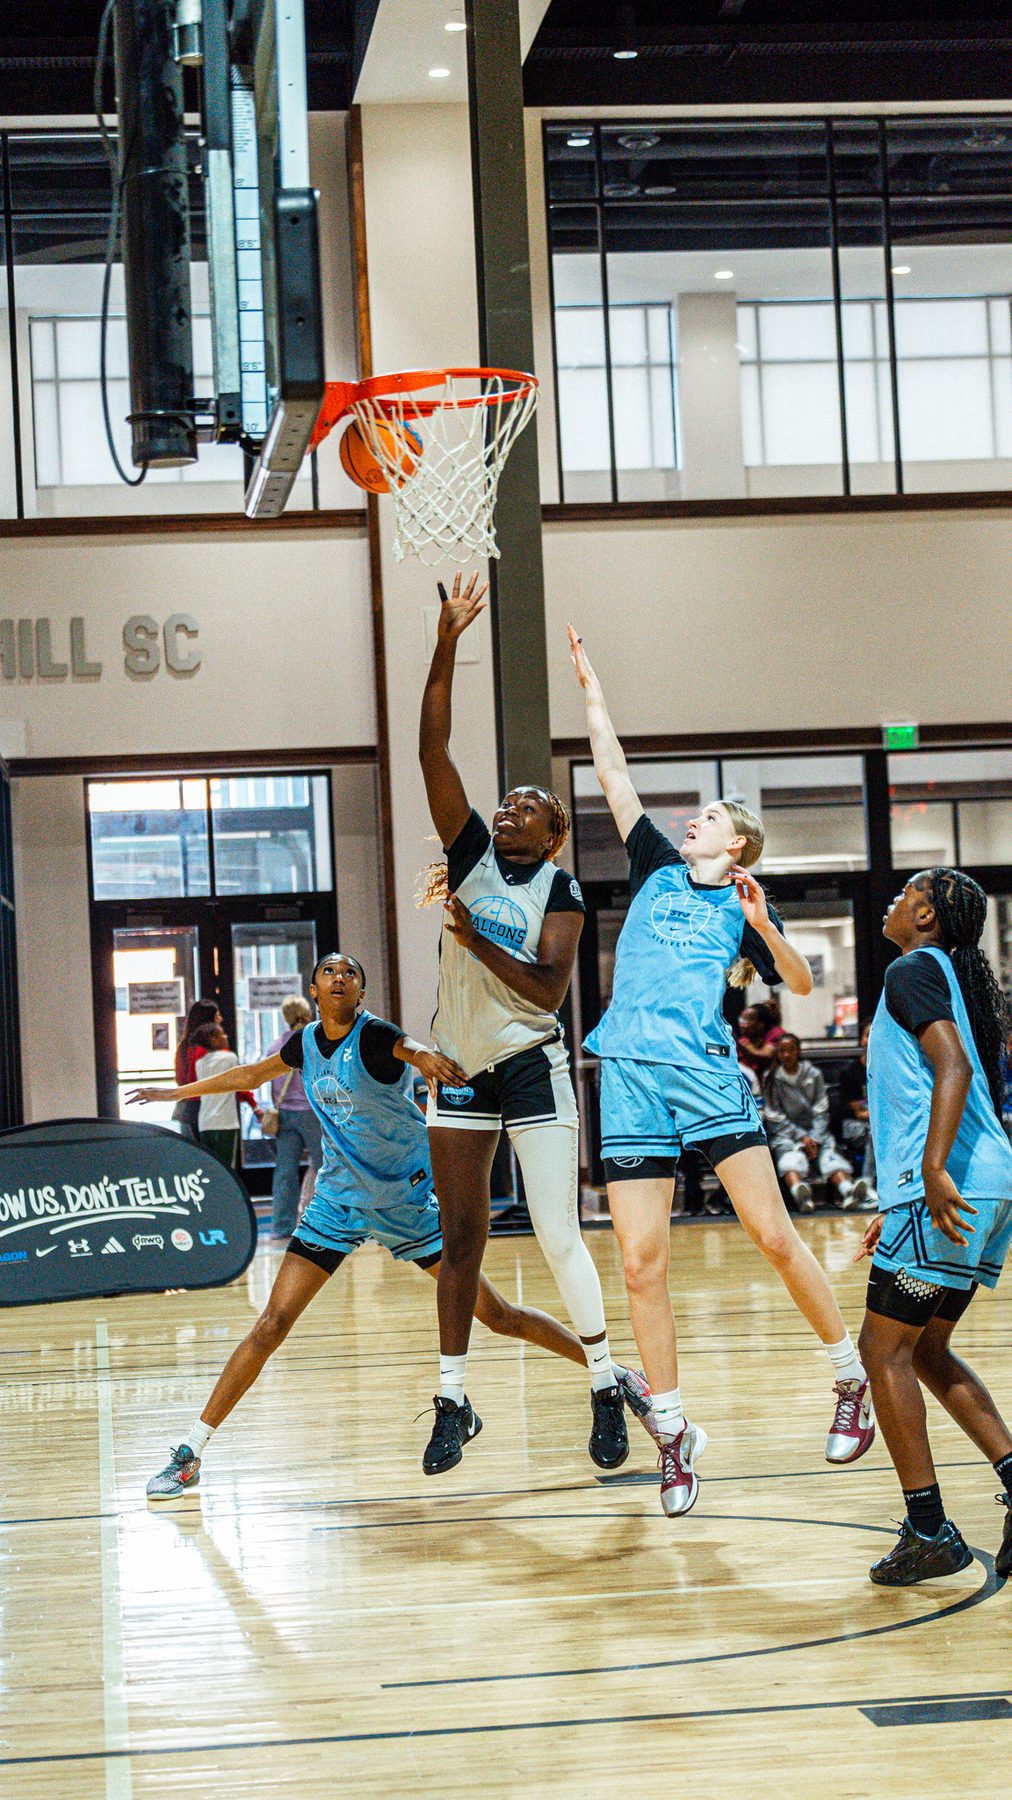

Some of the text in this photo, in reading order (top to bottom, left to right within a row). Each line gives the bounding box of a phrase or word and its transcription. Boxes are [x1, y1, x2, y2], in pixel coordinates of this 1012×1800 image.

[123, 613, 201, 676] SC
[472, 916, 527, 945] ALCONS
[119, 1177, 177, 1207] TELL
